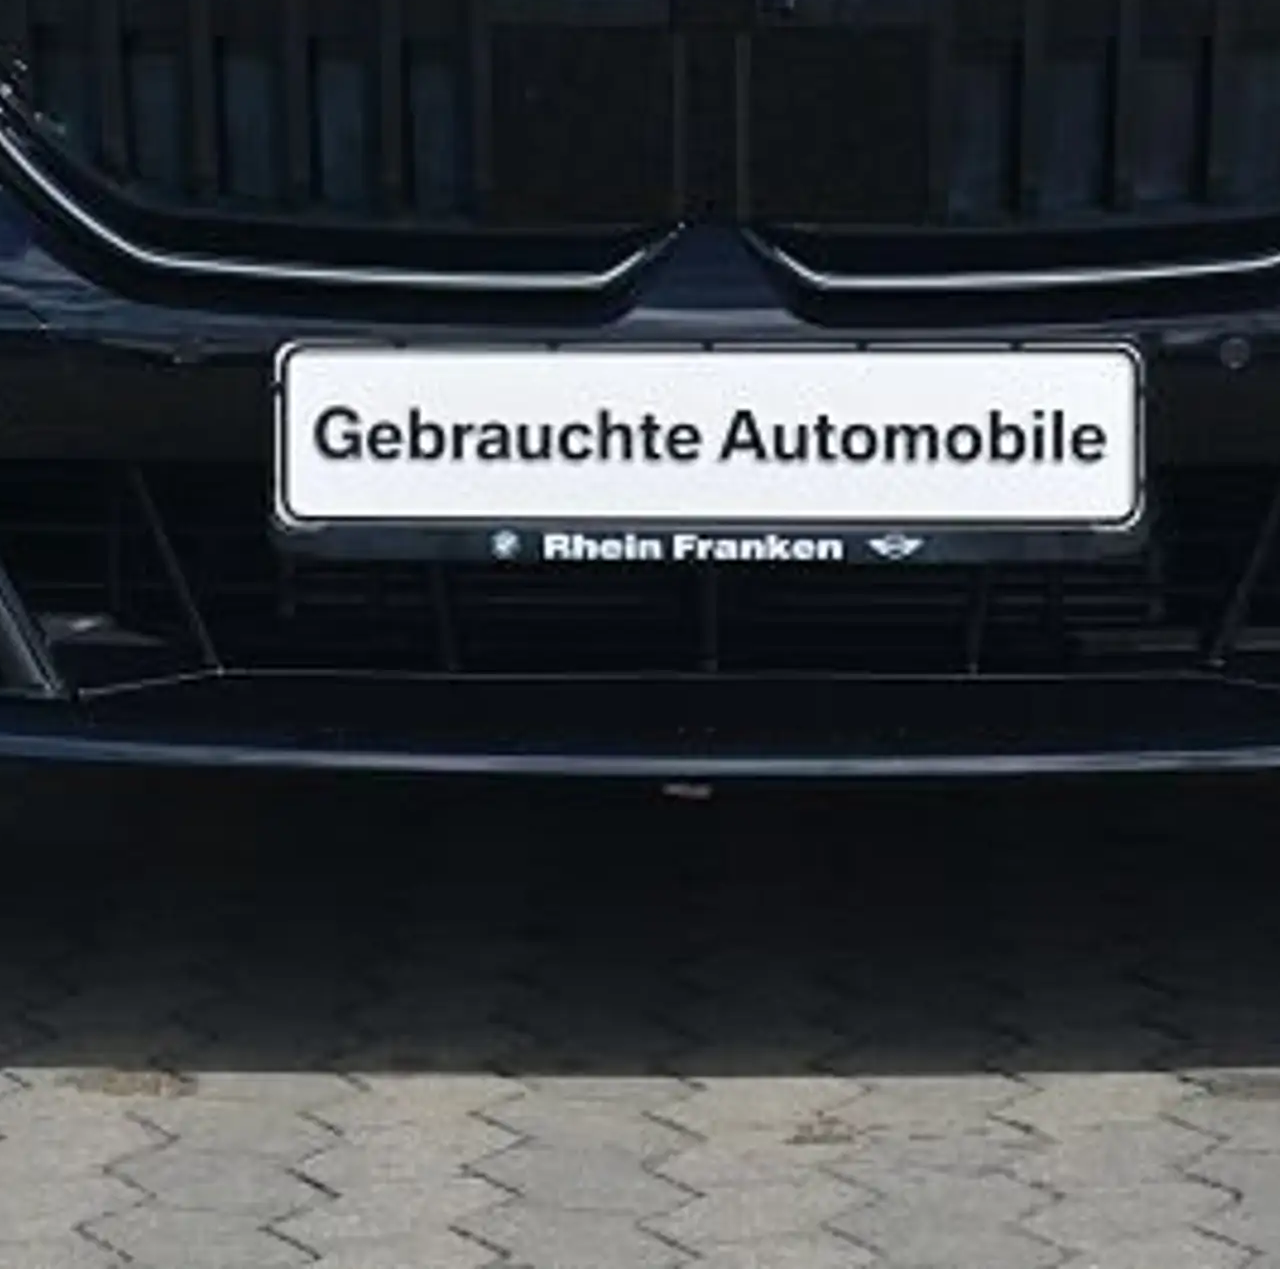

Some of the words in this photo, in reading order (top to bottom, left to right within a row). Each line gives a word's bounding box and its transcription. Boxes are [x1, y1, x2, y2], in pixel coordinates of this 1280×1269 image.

[313, 405, 703, 464] Gebrauchte
[719, 406, 1108, 464] Automobile
[542, 532, 663, 561] Rhein
[672, 532, 844, 561] Franken
